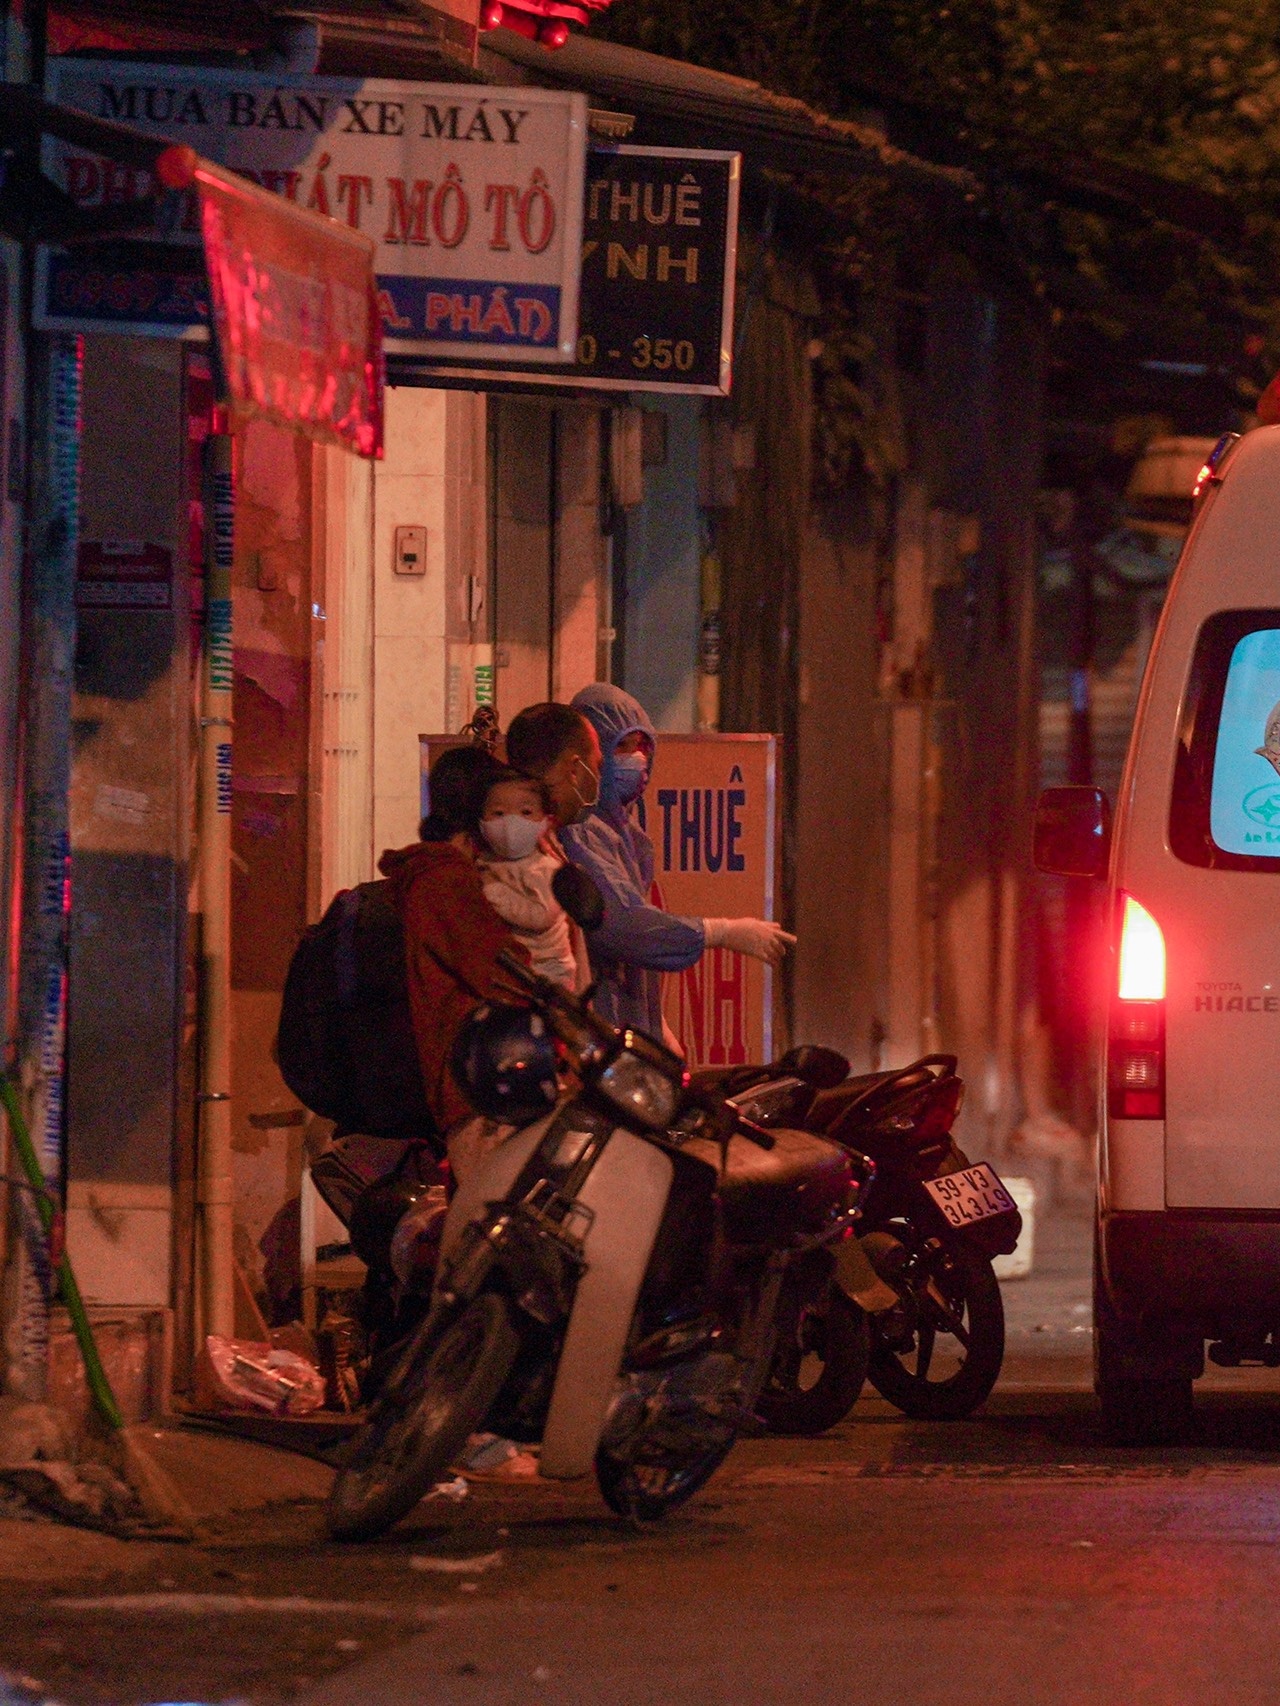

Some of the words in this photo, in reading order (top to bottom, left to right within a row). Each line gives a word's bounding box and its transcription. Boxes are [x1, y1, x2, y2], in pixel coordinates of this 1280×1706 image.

[101, 84, 208, 126] MUA
[228, 86, 329, 131] BÁN
[343, 100, 405, 136] XE
[422, 97, 529, 144] MÁY
[385, 162, 468, 249] MÔ
[484, 166, 556, 254] TÔ
[632, 337, 694, 371] 350
[658, 765, 745, 873] THUÊ
[1195, 996, 1279, 1012] HIACE
[1196, 982, 1242, 991] TOYOTA
[934, 1169, 989, 1201] 59-V3
[944, 1188, 1011, 1225] 343.49
